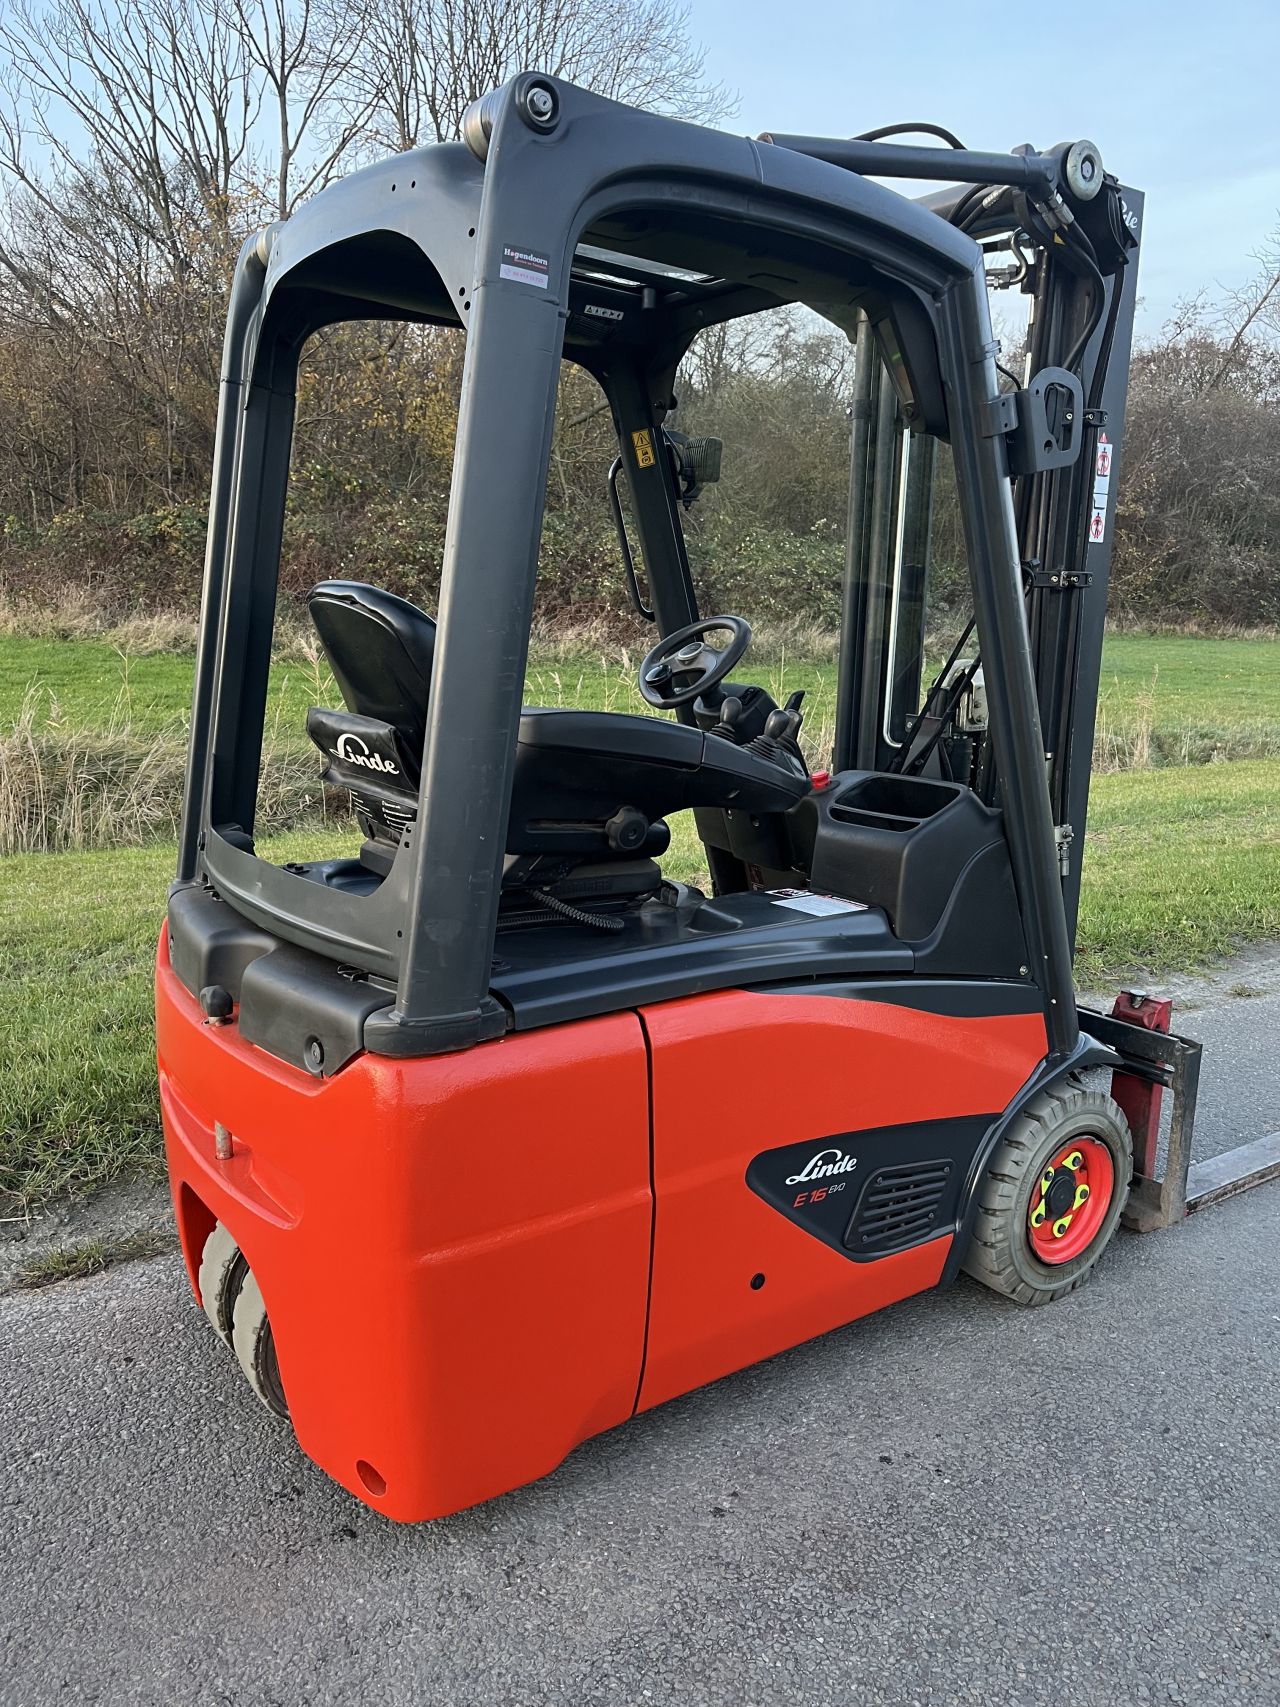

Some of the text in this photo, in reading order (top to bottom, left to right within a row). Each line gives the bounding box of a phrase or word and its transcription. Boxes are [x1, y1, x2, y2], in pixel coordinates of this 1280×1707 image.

[329, 733, 400, 775] Linde
[785, 1149, 858, 1185] Linde
[793, 1192, 808, 1208] E
[809, 1187, 829, 1204] 16
